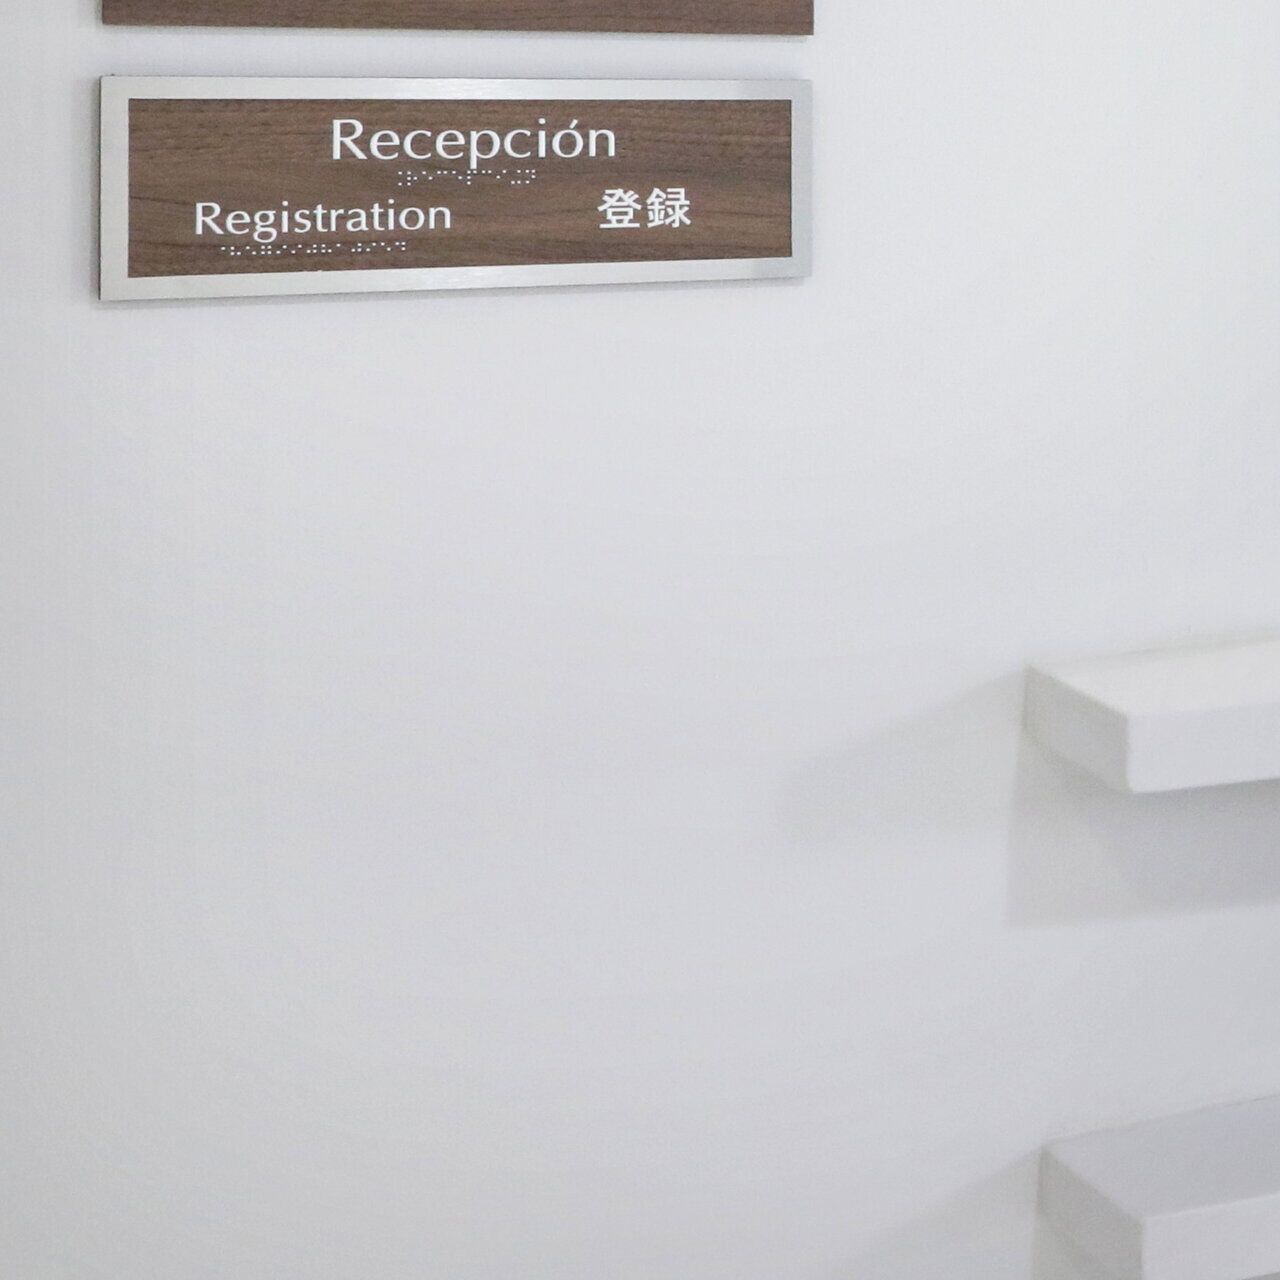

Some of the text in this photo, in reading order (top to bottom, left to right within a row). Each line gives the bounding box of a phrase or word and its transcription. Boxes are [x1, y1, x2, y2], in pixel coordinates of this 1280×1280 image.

[332, 117, 617, 169] Recepción
[194, 198, 452, 243] Registration
[597, 187, 692, 229] 登録
